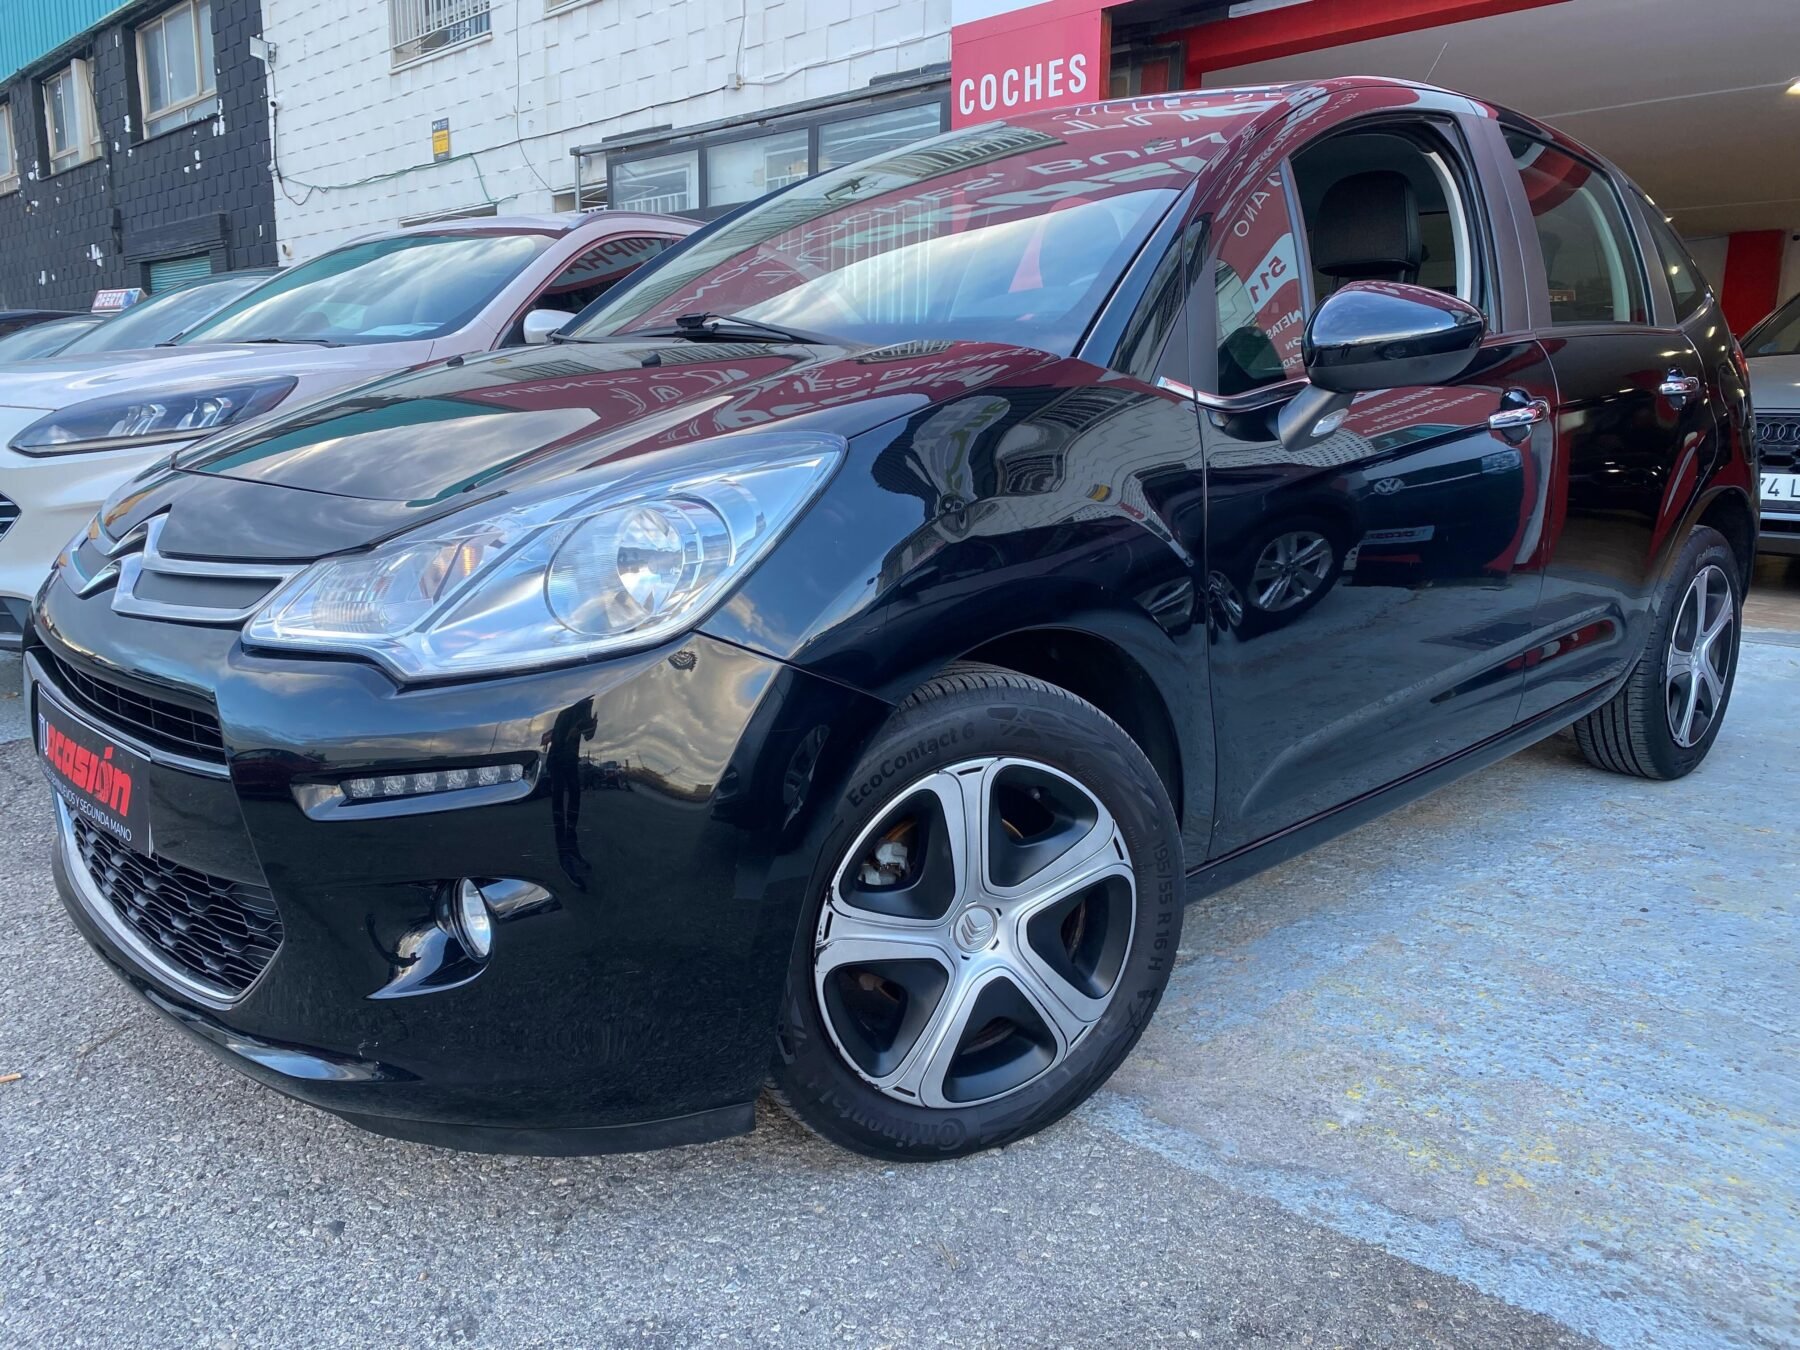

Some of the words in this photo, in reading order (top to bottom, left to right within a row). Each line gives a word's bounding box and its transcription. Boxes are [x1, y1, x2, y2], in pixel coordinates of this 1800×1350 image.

[959, 53, 1087, 116] COCHES
[94, 291, 126, 308] OFERTA
[846, 727, 959, 808] EcoContact
[962, 721, 976, 742] 6
[79, 798, 111, 829] SEGUNDA
[110, 819, 133, 842] MANO
[1152, 838, 1173, 900] 195/55
[1157, 910, 1173, 926] R
[1153, 930, 1169, 952] 16
